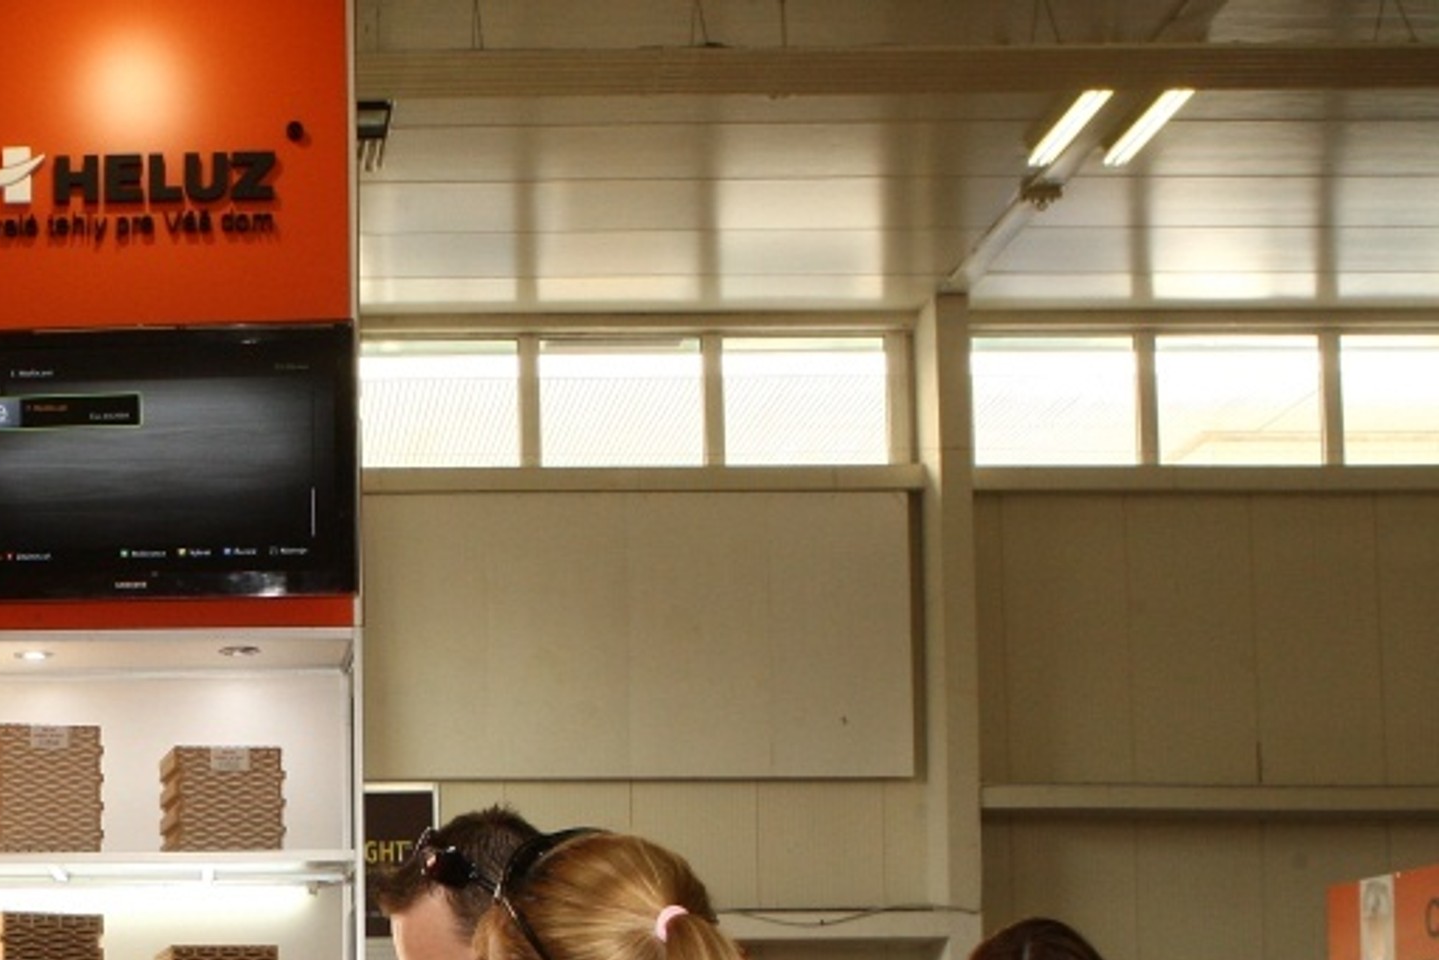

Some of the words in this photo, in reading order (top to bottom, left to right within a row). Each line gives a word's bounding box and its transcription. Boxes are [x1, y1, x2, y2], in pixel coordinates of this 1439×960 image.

[53, 150, 276, 204] HELUZ
[48, 211, 107, 242] tehly
[116, 214, 155, 240] pre
[221, 209, 274, 233] dom
[364, 840, 408, 864] GHT
